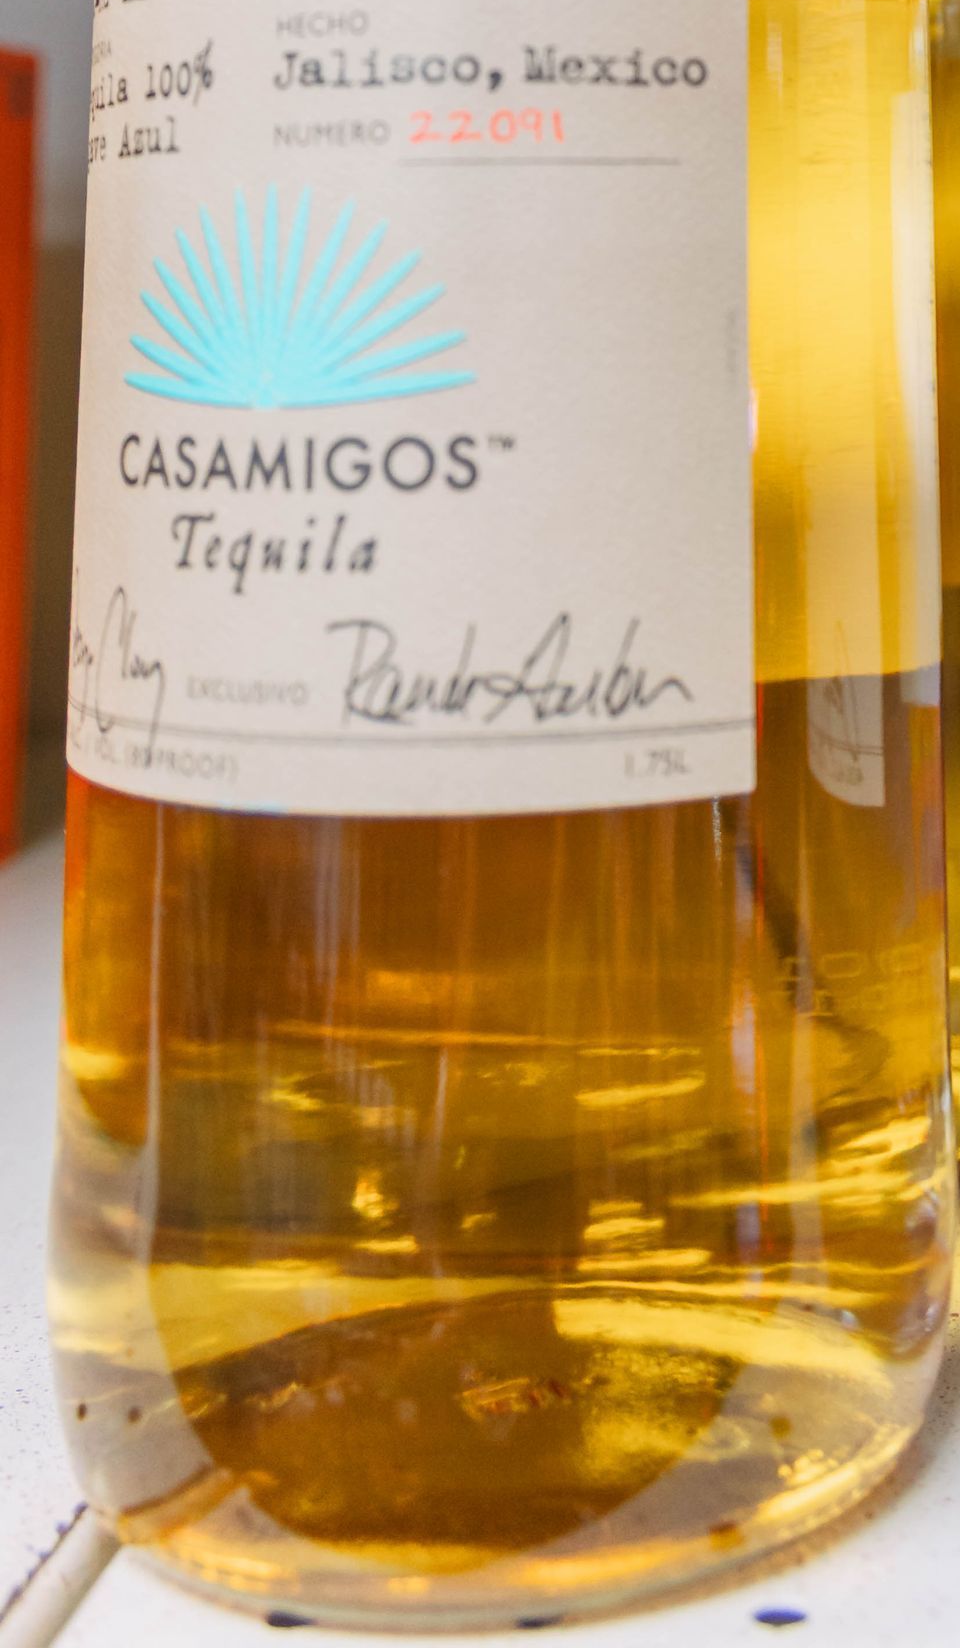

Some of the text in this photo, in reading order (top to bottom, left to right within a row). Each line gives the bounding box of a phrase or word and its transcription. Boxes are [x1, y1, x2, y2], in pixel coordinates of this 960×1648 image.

[276, 10, 370, 38] HECHO
[146, 38, 214, 107] 100%
[272, 46, 710, 92] Jalisco, Mexico
[118, 115, 179, 159] Azul
[273, 108, 567, 147] NUMERO 22091
[171, 512, 381, 595] Tequila
[187, 670, 309, 706] EXCLUSIVO
